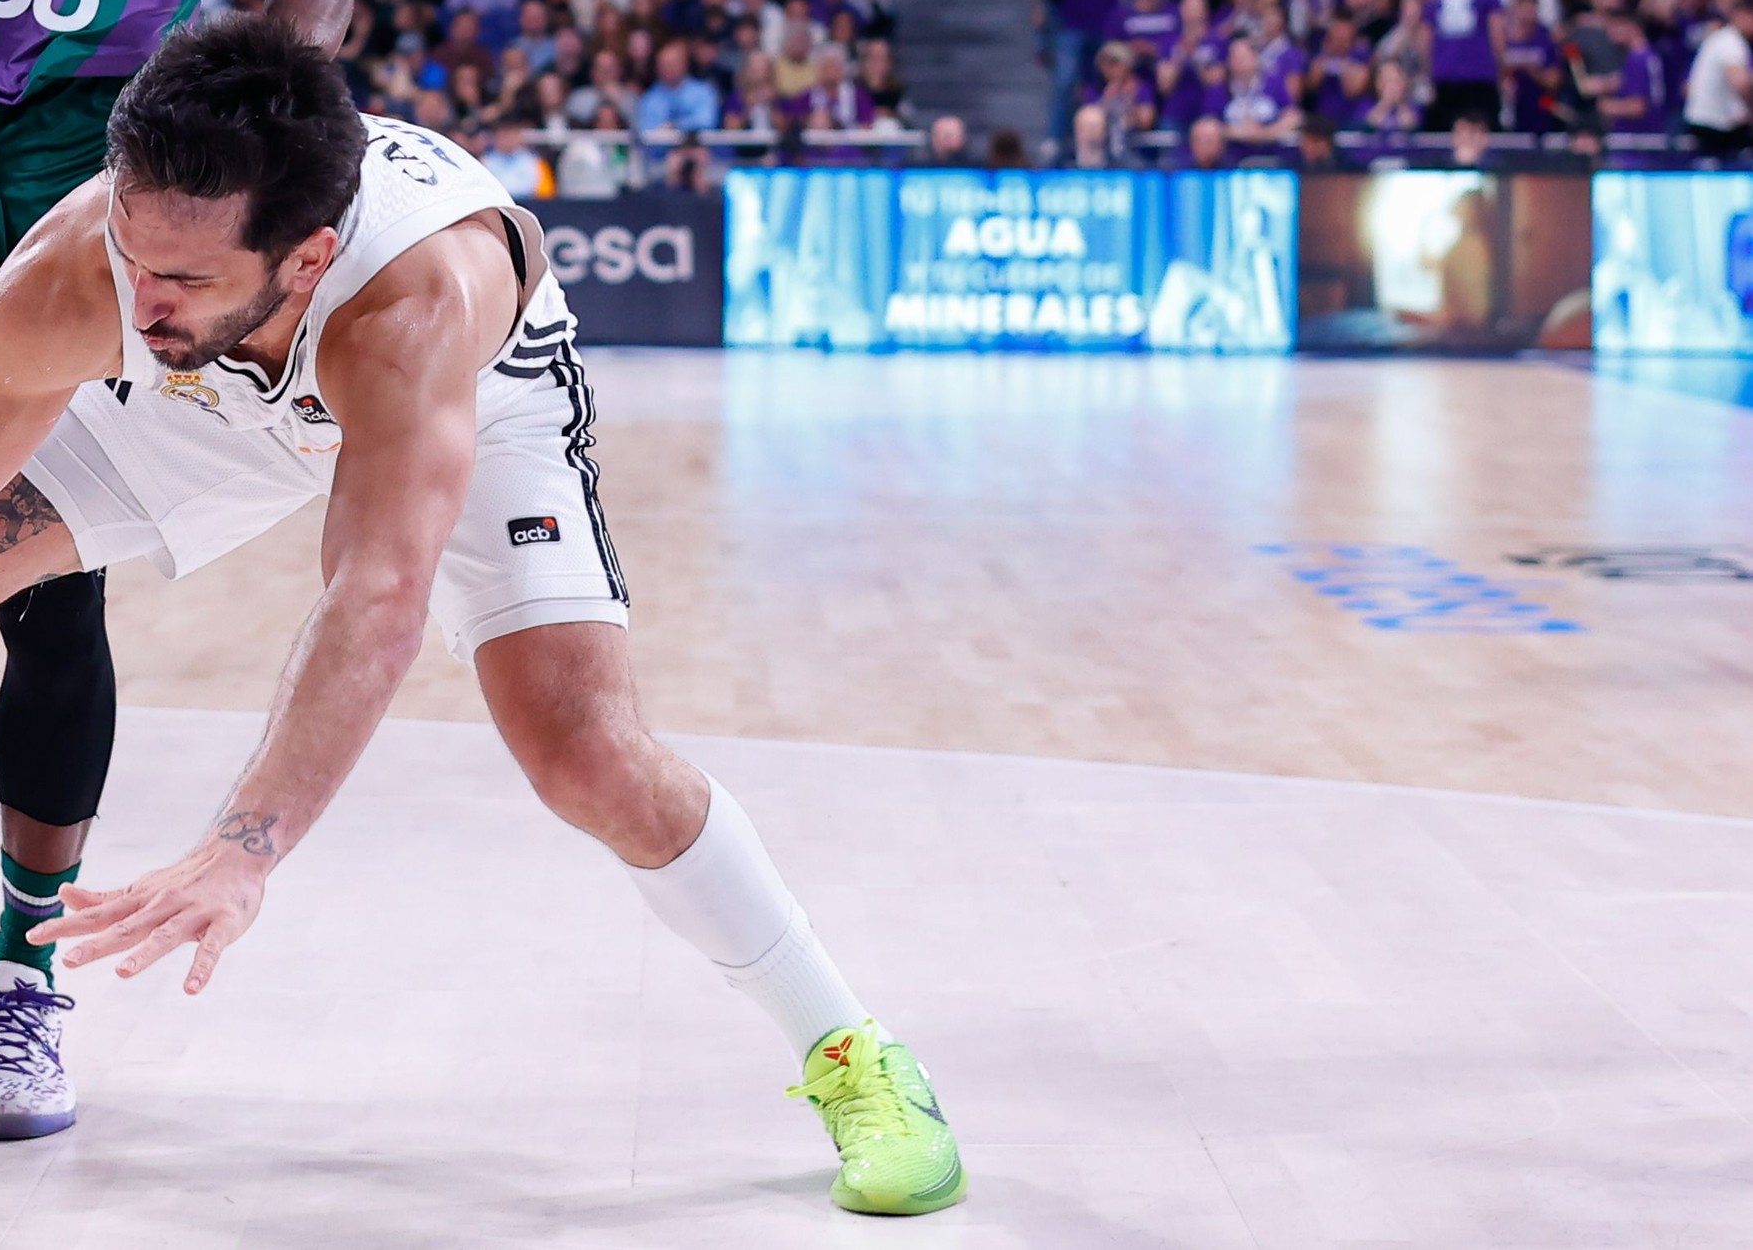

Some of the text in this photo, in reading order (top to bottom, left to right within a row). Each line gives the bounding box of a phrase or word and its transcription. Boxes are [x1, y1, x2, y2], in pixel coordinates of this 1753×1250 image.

[545, 225, 693, 284] esa
[944, 215, 1087, 258] AGUA
[885, 292, 1145, 337] MINERALES
[514, 526, 550, 542] acb
